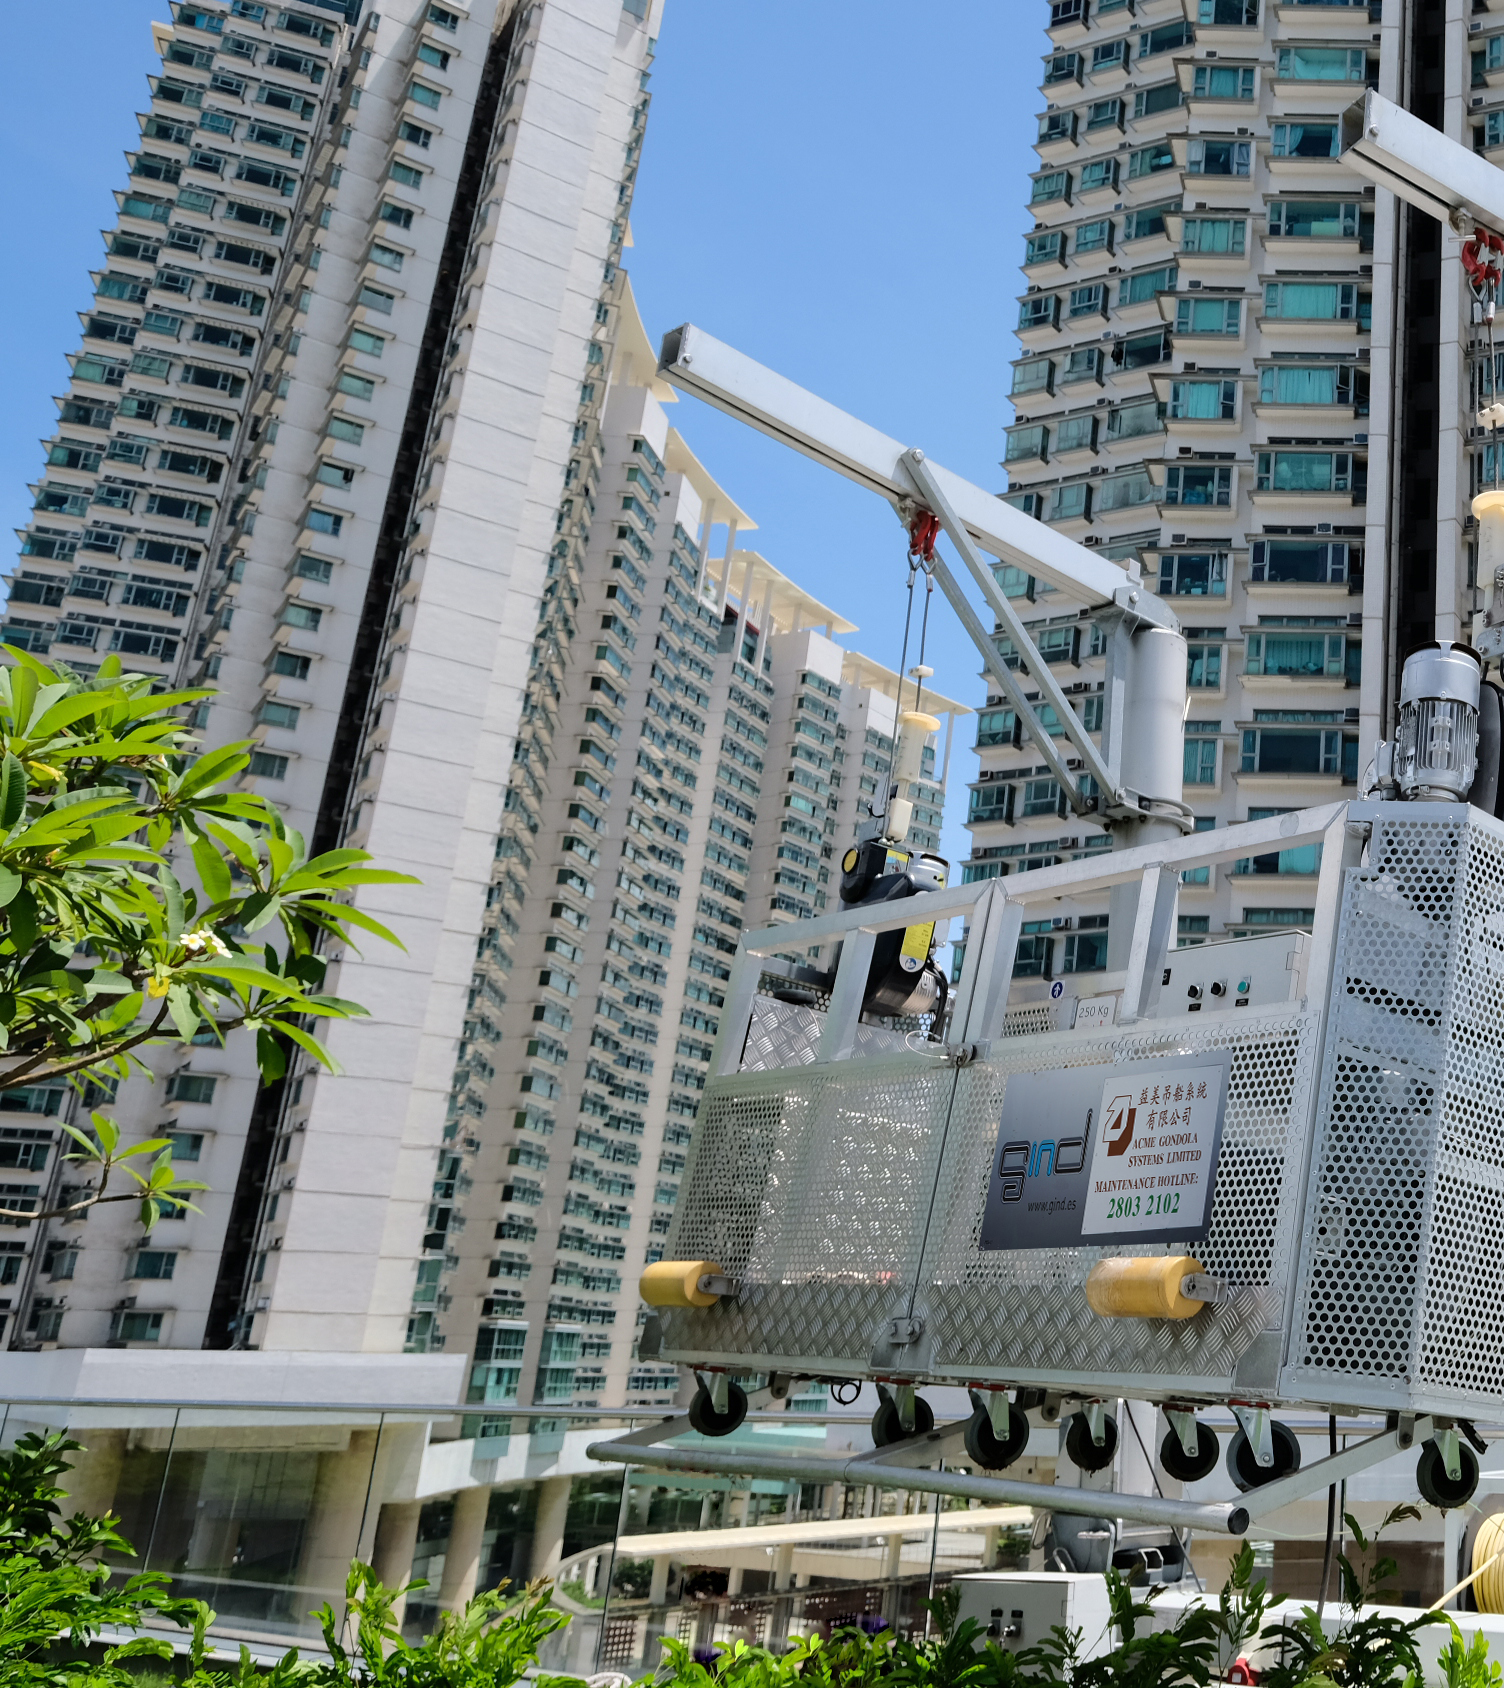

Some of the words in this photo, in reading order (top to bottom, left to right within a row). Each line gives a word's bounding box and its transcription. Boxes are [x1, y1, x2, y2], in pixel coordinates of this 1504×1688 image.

[1079, 1005, 1096, 1018] 250
[1097, 1005, 1109, 1018] Kg
[1145, 1106, 1192, 1131] 有限公司
[1132, 1136, 1157, 1150] ACME
[1159, 1132, 1198, 1147] GONDOLA
[1127, 1153, 1165, 1168] SYSTEMS
[1166, 1149, 1202, 1165] LIMITED
[1094, 1176, 1156, 1193] MAINTENANCE
[1157, 1172, 1199, 1187] HOTLINE:
[1027, 1196, 1077, 1216] www.gind.es
[1106, 1195, 1141, 1219] 2803
[1145, 1192, 1180, 1216] 2102
